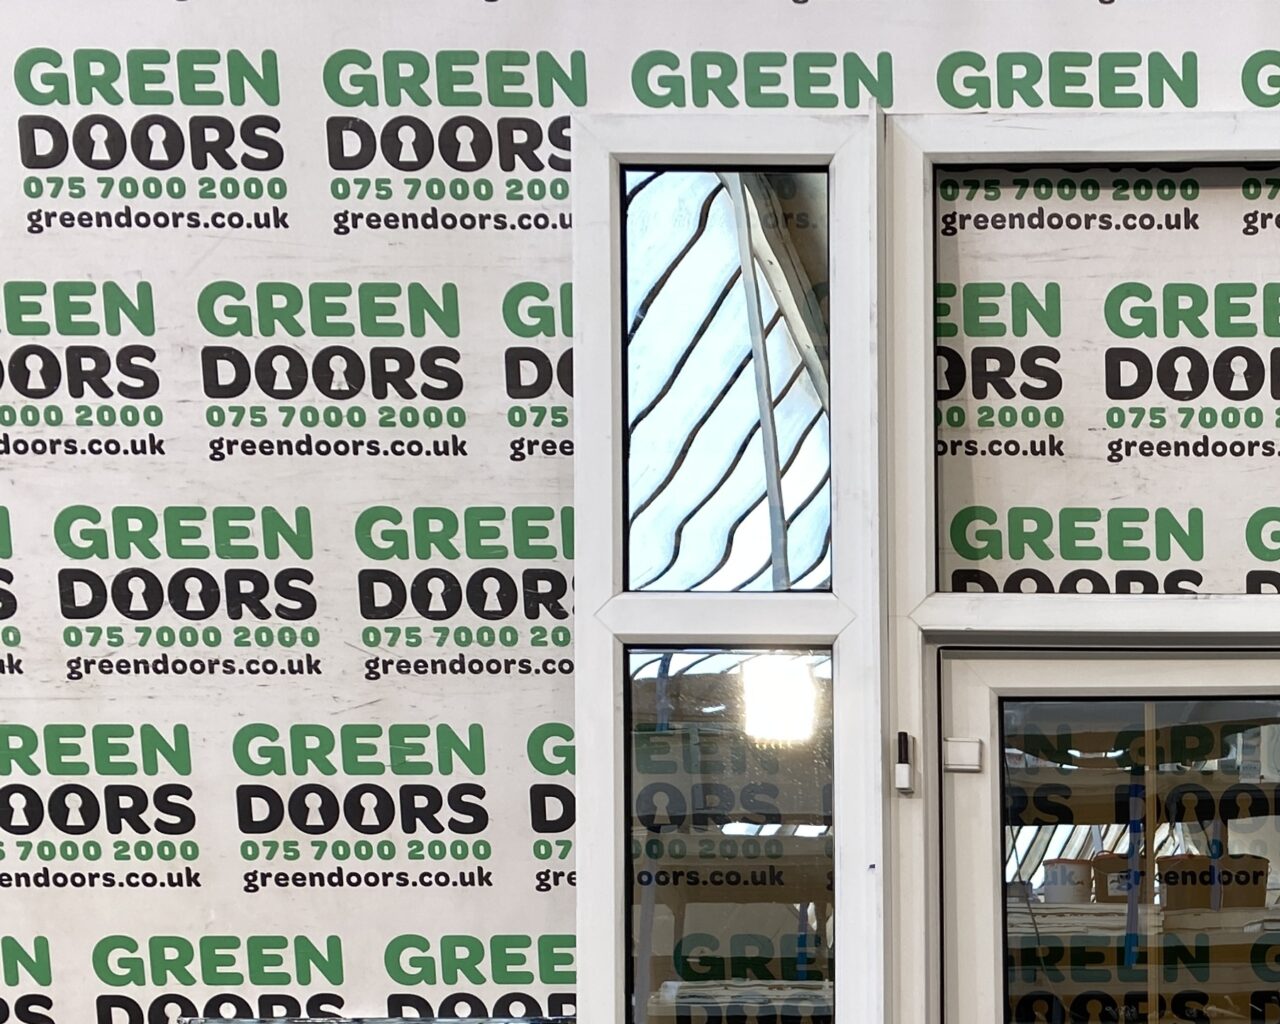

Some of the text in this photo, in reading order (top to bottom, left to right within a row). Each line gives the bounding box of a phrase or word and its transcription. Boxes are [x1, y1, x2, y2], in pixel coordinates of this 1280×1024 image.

[14, 48, 280, 106] GREEN
[323, 49, 587, 108] GREEN
[631, 50, 893, 108] GREEN
[937, 51, 1198, 109] GREEN
[18, 114, 284, 171] DOORS
[24, 176, 287, 200] 075 7000 2000
[331, 178, 493, 201] 075 7000
[940, 178, 1199, 202] 075 7000 2000
[27, 206, 289, 234] greendoors.co.uk
[941, 208, 1199, 236] greendoors.co.uk
[197, 281, 460, 338] GREEN
[201, 345, 463, 401] DOORS
[206, 405, 466, 428] 075 7000 2000
[508, 406, 568, 427] 075
[977, 406, 1064, 428] 2000
[1106, 407, 1166, 428] 075
[1178, 407, 1263, 429] 7000
[209, 434, 468, 461] greendoors.co.uk
[54, 505, 313, 560] GREEN
[949, 507, 1204, 562] GREEN
[58, 568, 317, 621] DOORS
[358, 568, 574, 621] DOOR
[63, 626, 320, 648] 075 7000 2000
[362, 626, 518, 647] 075 7000
[67, 653, 322, 680] greendoors.co.uk
[233, 723, 486, 776] GREEN
[236, 783, 489, 835] DOORS
[16, 840, 199, 861] 7000 2000
[240, 840, 491, 861] 075 7000 2000
[244, 866, 493, 893] greendoors.co.uk
[92, 935, 344, 987] GREEN
[1004, 932, 1211, 983] REEN
